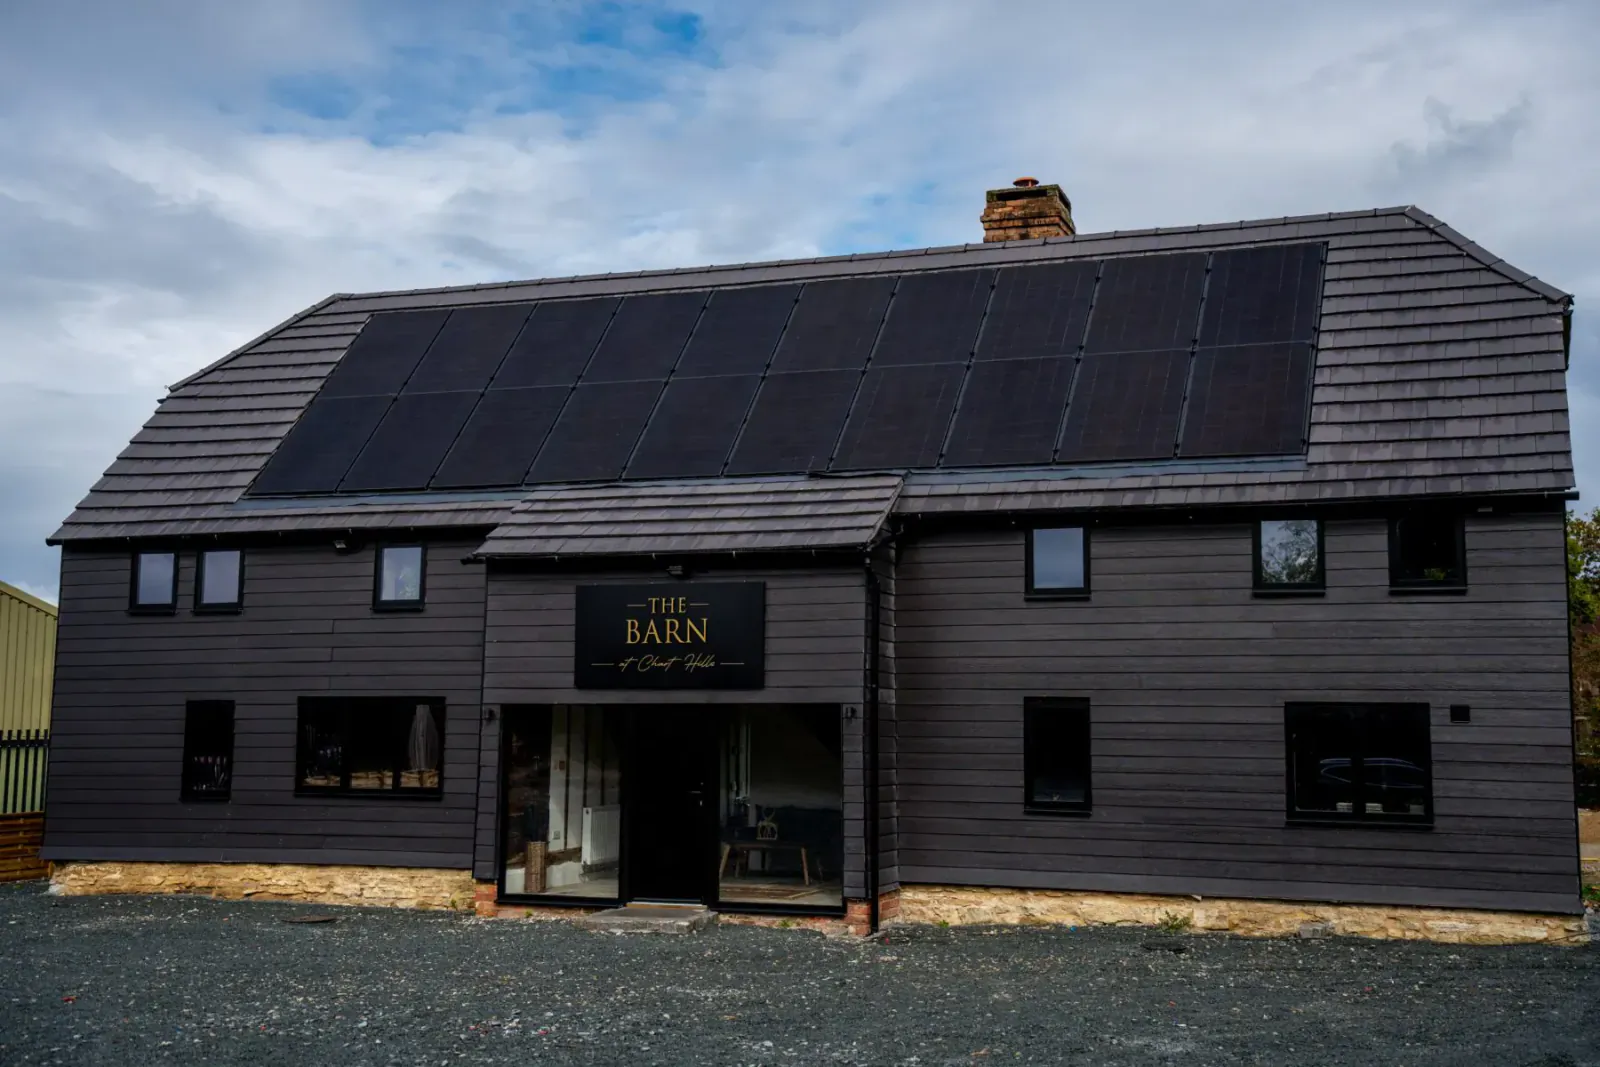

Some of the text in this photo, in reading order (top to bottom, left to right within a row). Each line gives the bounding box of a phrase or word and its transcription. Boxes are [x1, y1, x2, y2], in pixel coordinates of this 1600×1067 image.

[648, 597, 687, 614] THE
[625, 617, 708, 644] BARN
[618, 652, 716, 673] at Chart Hills
